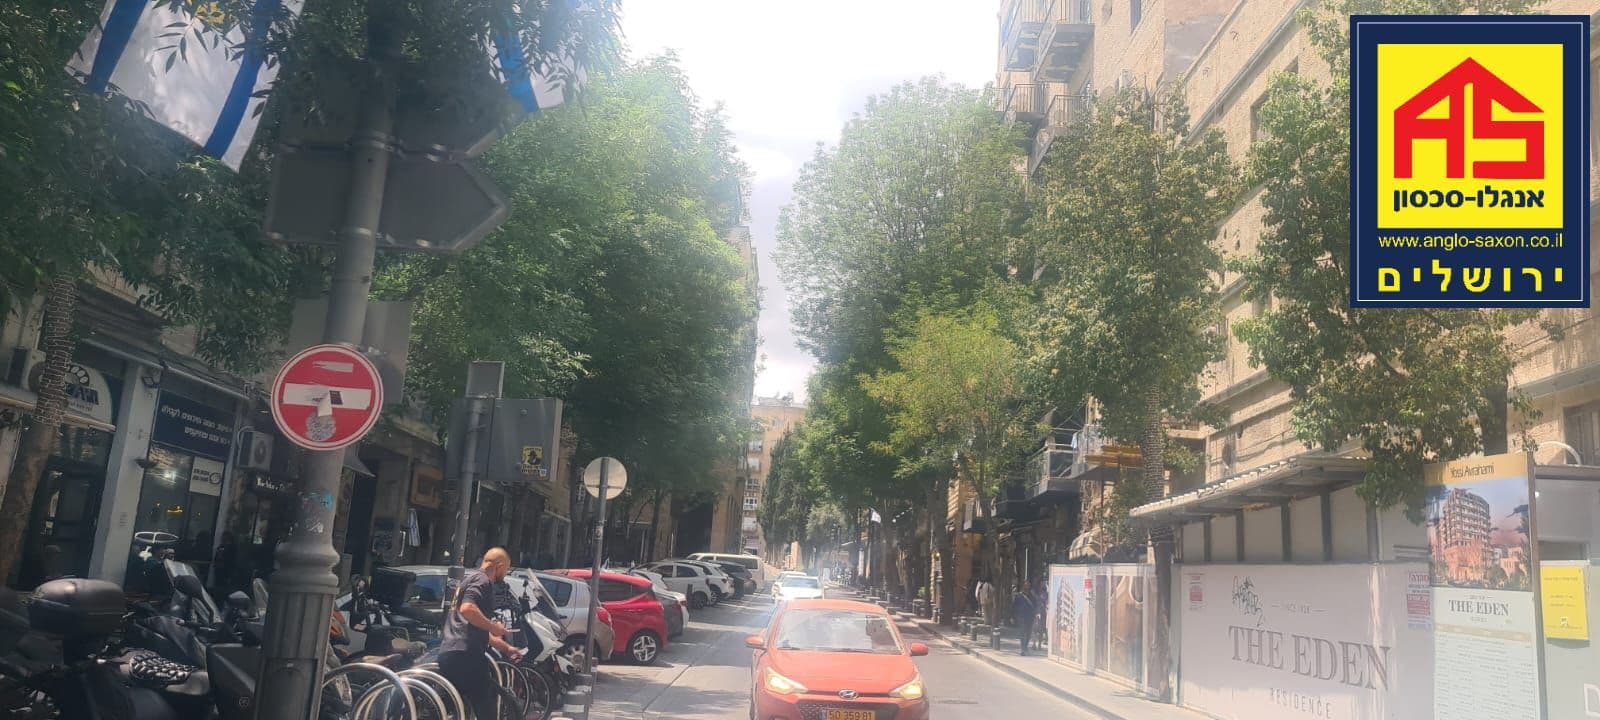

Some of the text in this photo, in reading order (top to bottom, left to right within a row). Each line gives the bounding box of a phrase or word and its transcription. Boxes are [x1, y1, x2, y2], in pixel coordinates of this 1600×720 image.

[1448, 599, 1473, 613] THE
[1476, 601, 1509, 616] EDEN
[1228, 625, 1285, 670] THE
[1291, 634, 1391, 692] EDEN
[1270, 687, 1332, 719] RESIDENCE
